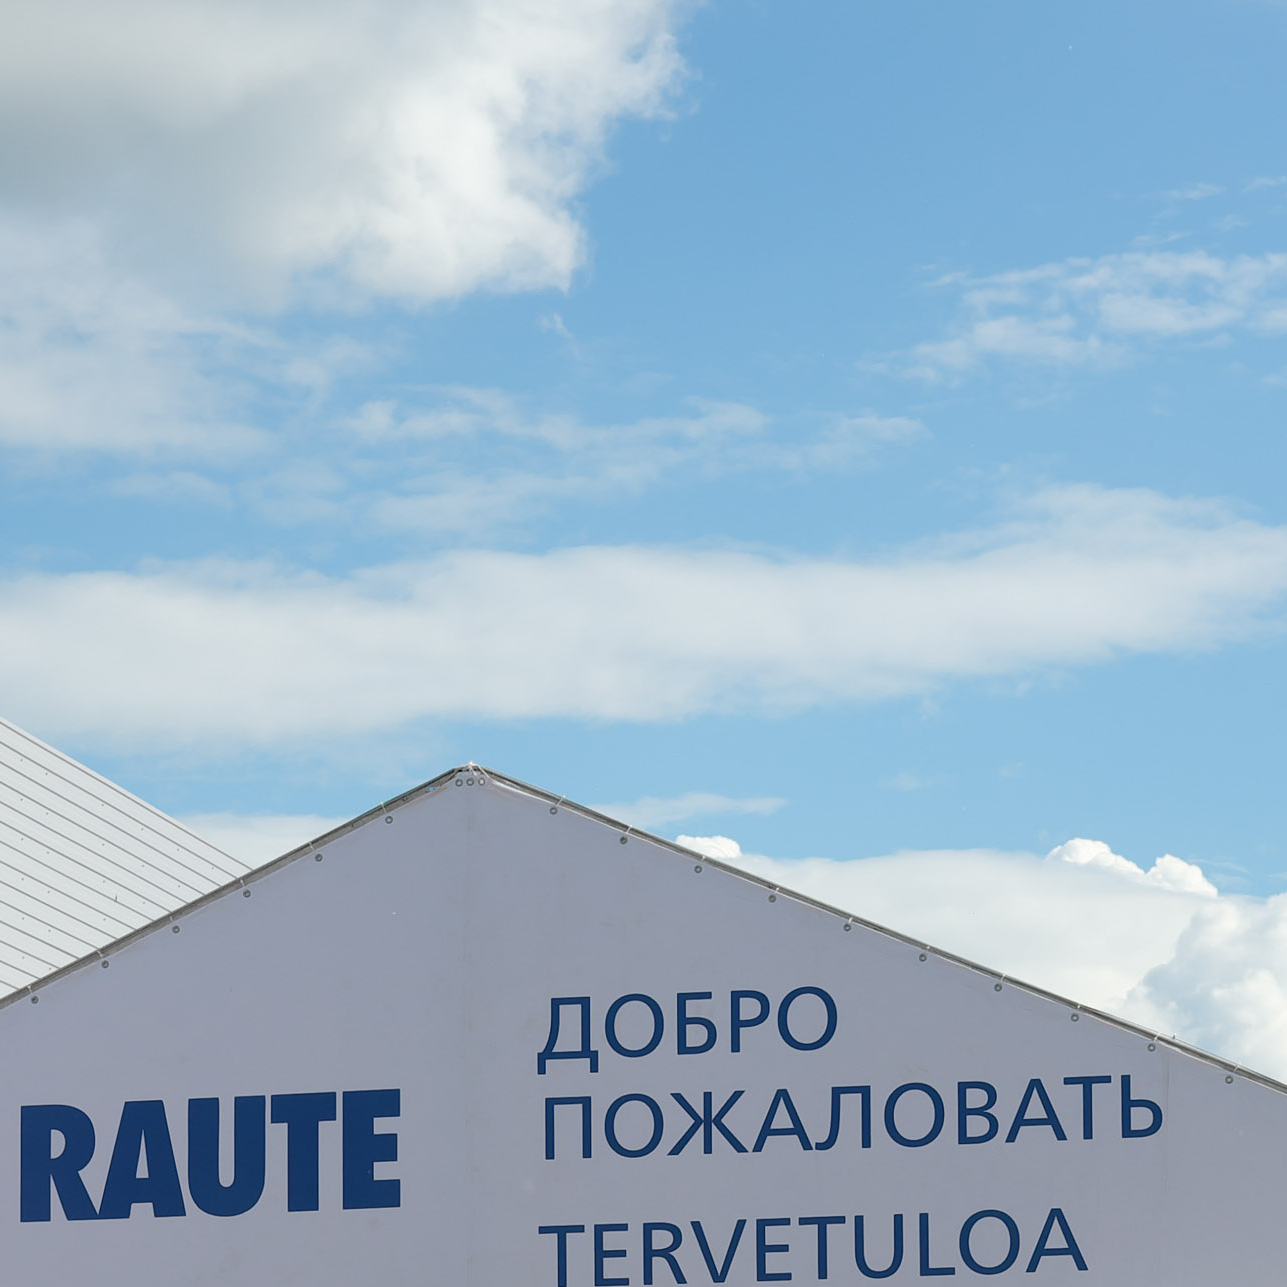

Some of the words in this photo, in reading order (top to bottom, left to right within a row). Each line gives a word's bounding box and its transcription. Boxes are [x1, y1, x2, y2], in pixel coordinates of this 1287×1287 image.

[536, 985, 838, 1075] ДОБРО
[19, 1088, 401, 1223] RAUTE
[544, 1074, 1163, 1161] ПОЖАЛОВАТЬ
